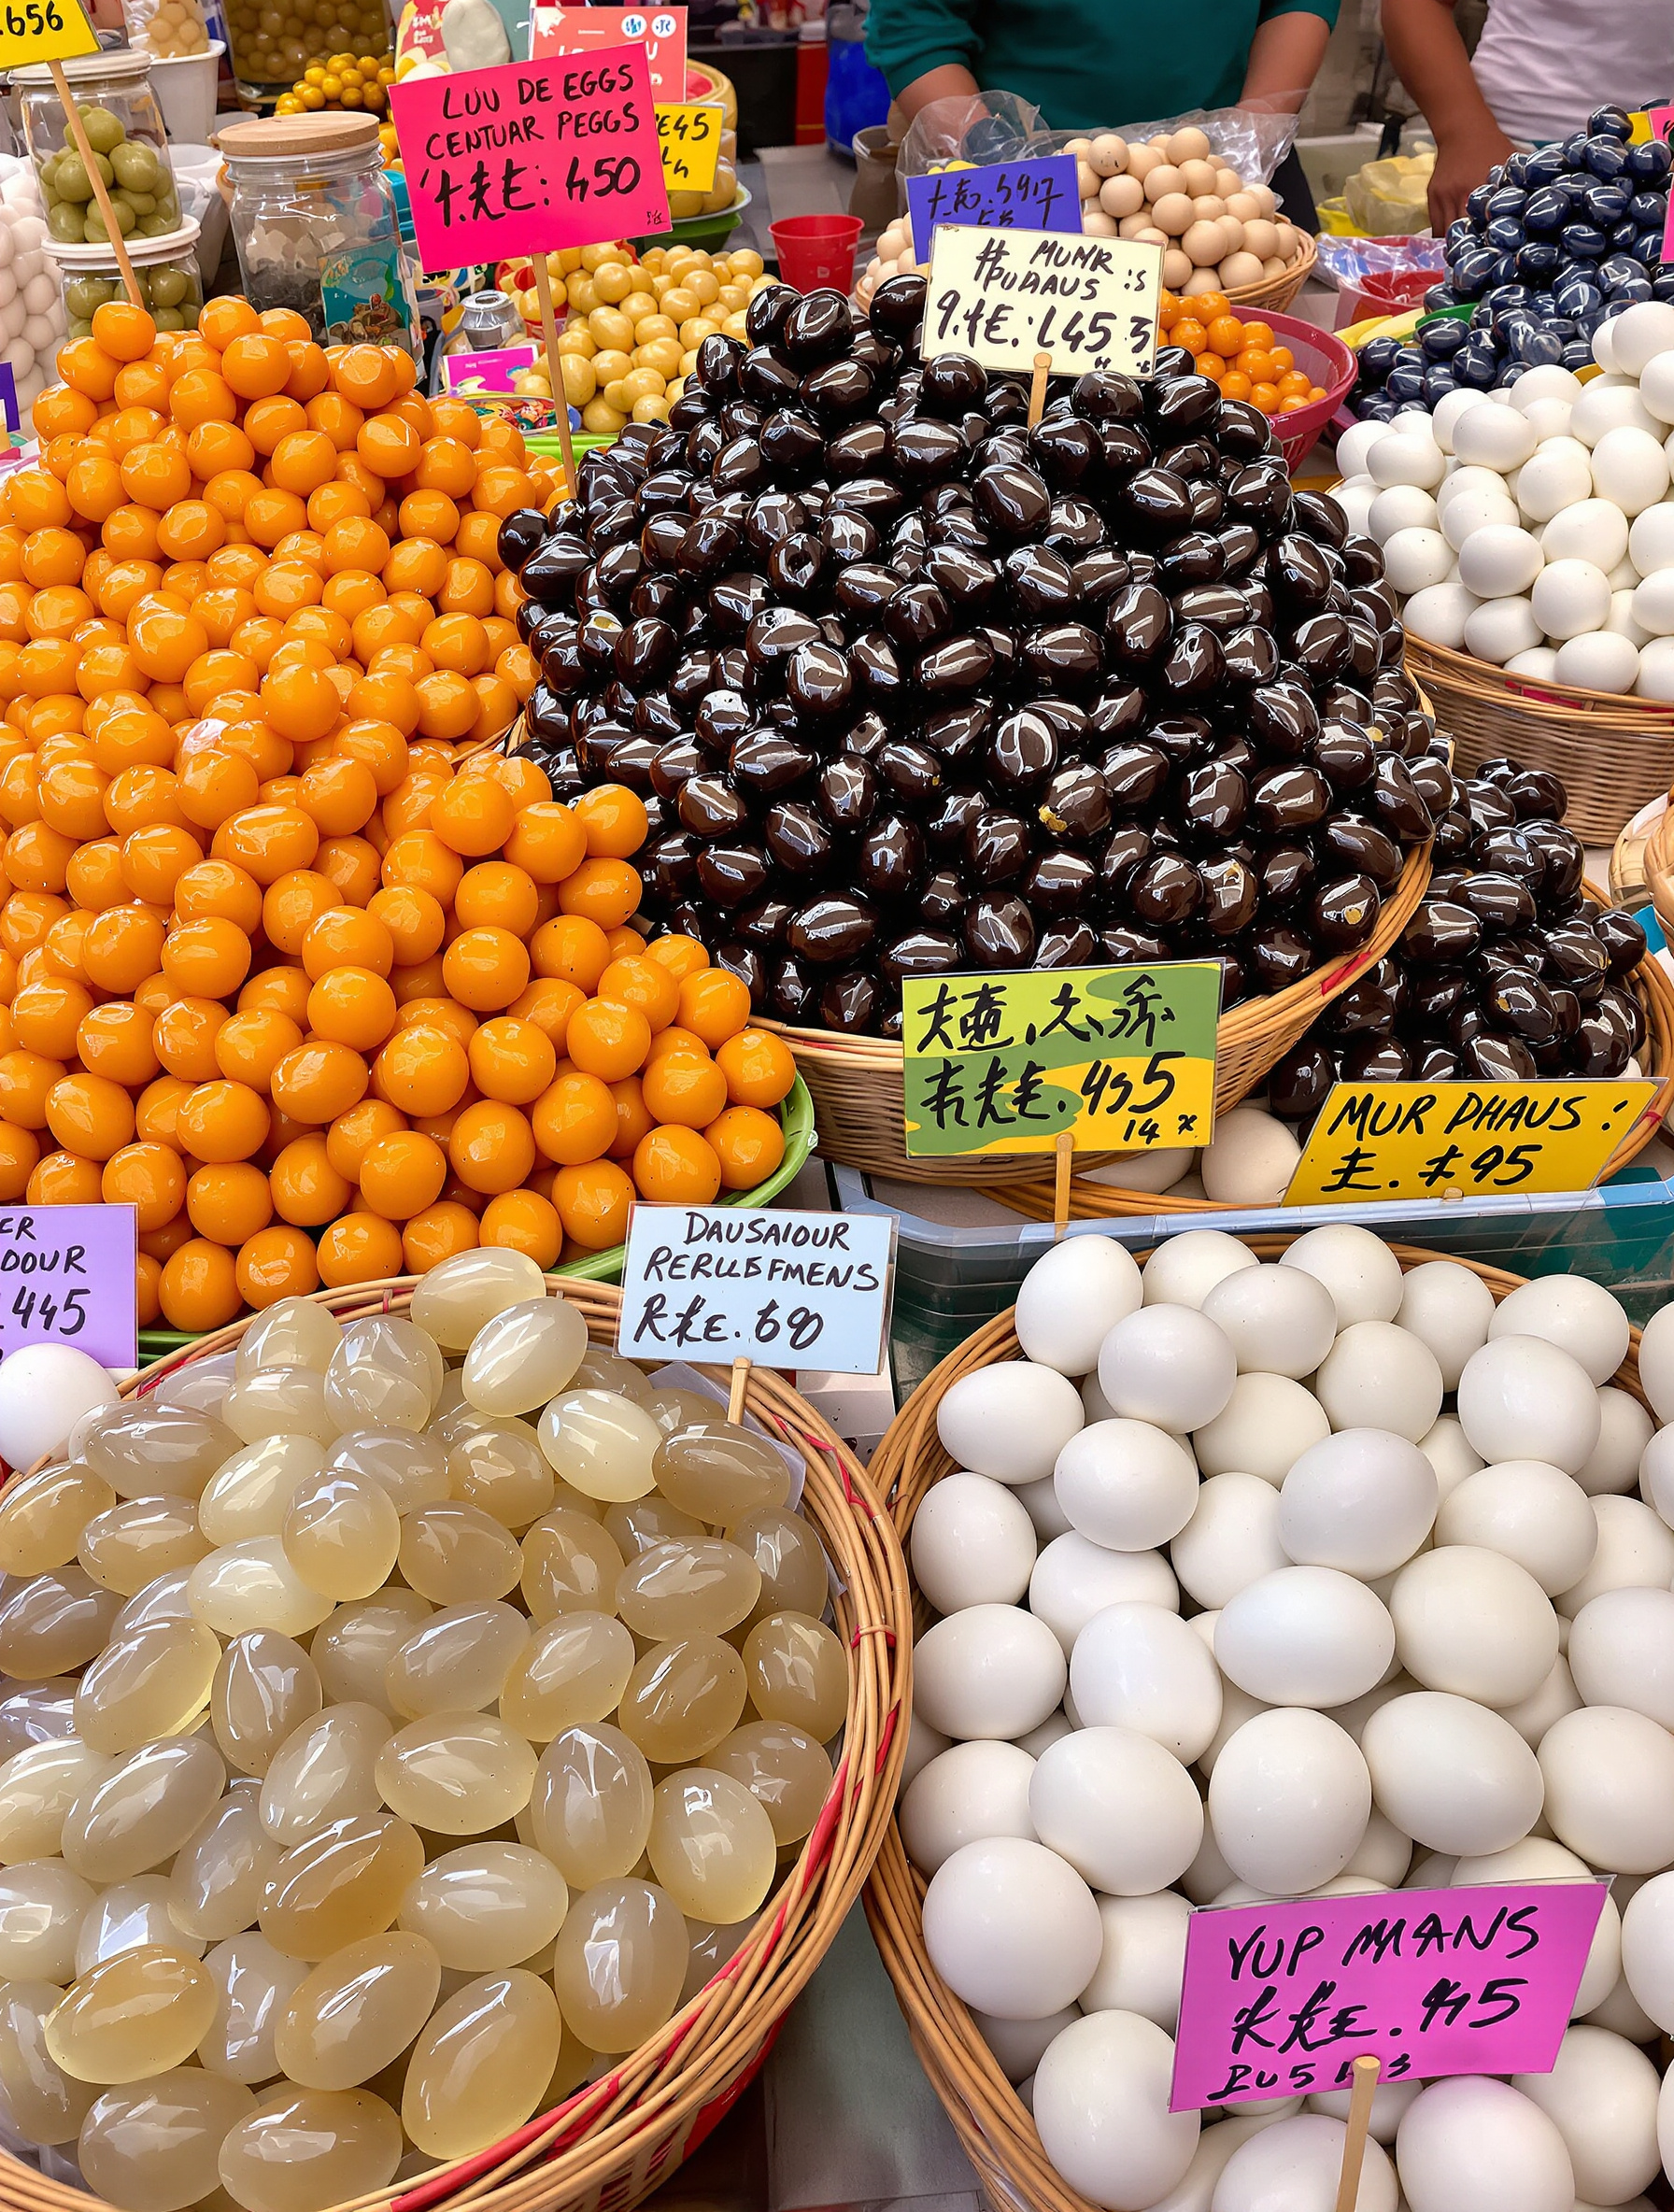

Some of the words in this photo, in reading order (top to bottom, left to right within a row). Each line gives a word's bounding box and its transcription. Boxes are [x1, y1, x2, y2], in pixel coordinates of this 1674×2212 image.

[518, 78, 553, 106] DE
[563, 64, 634, 102] EGGS
[425, 115, 545, 161] CENTUAR
[557, 102, 640, 140] PEGGS
[1326, 1092, 1438, 1142] MUR
[1227, 1924, 1325, 1981] YUP
